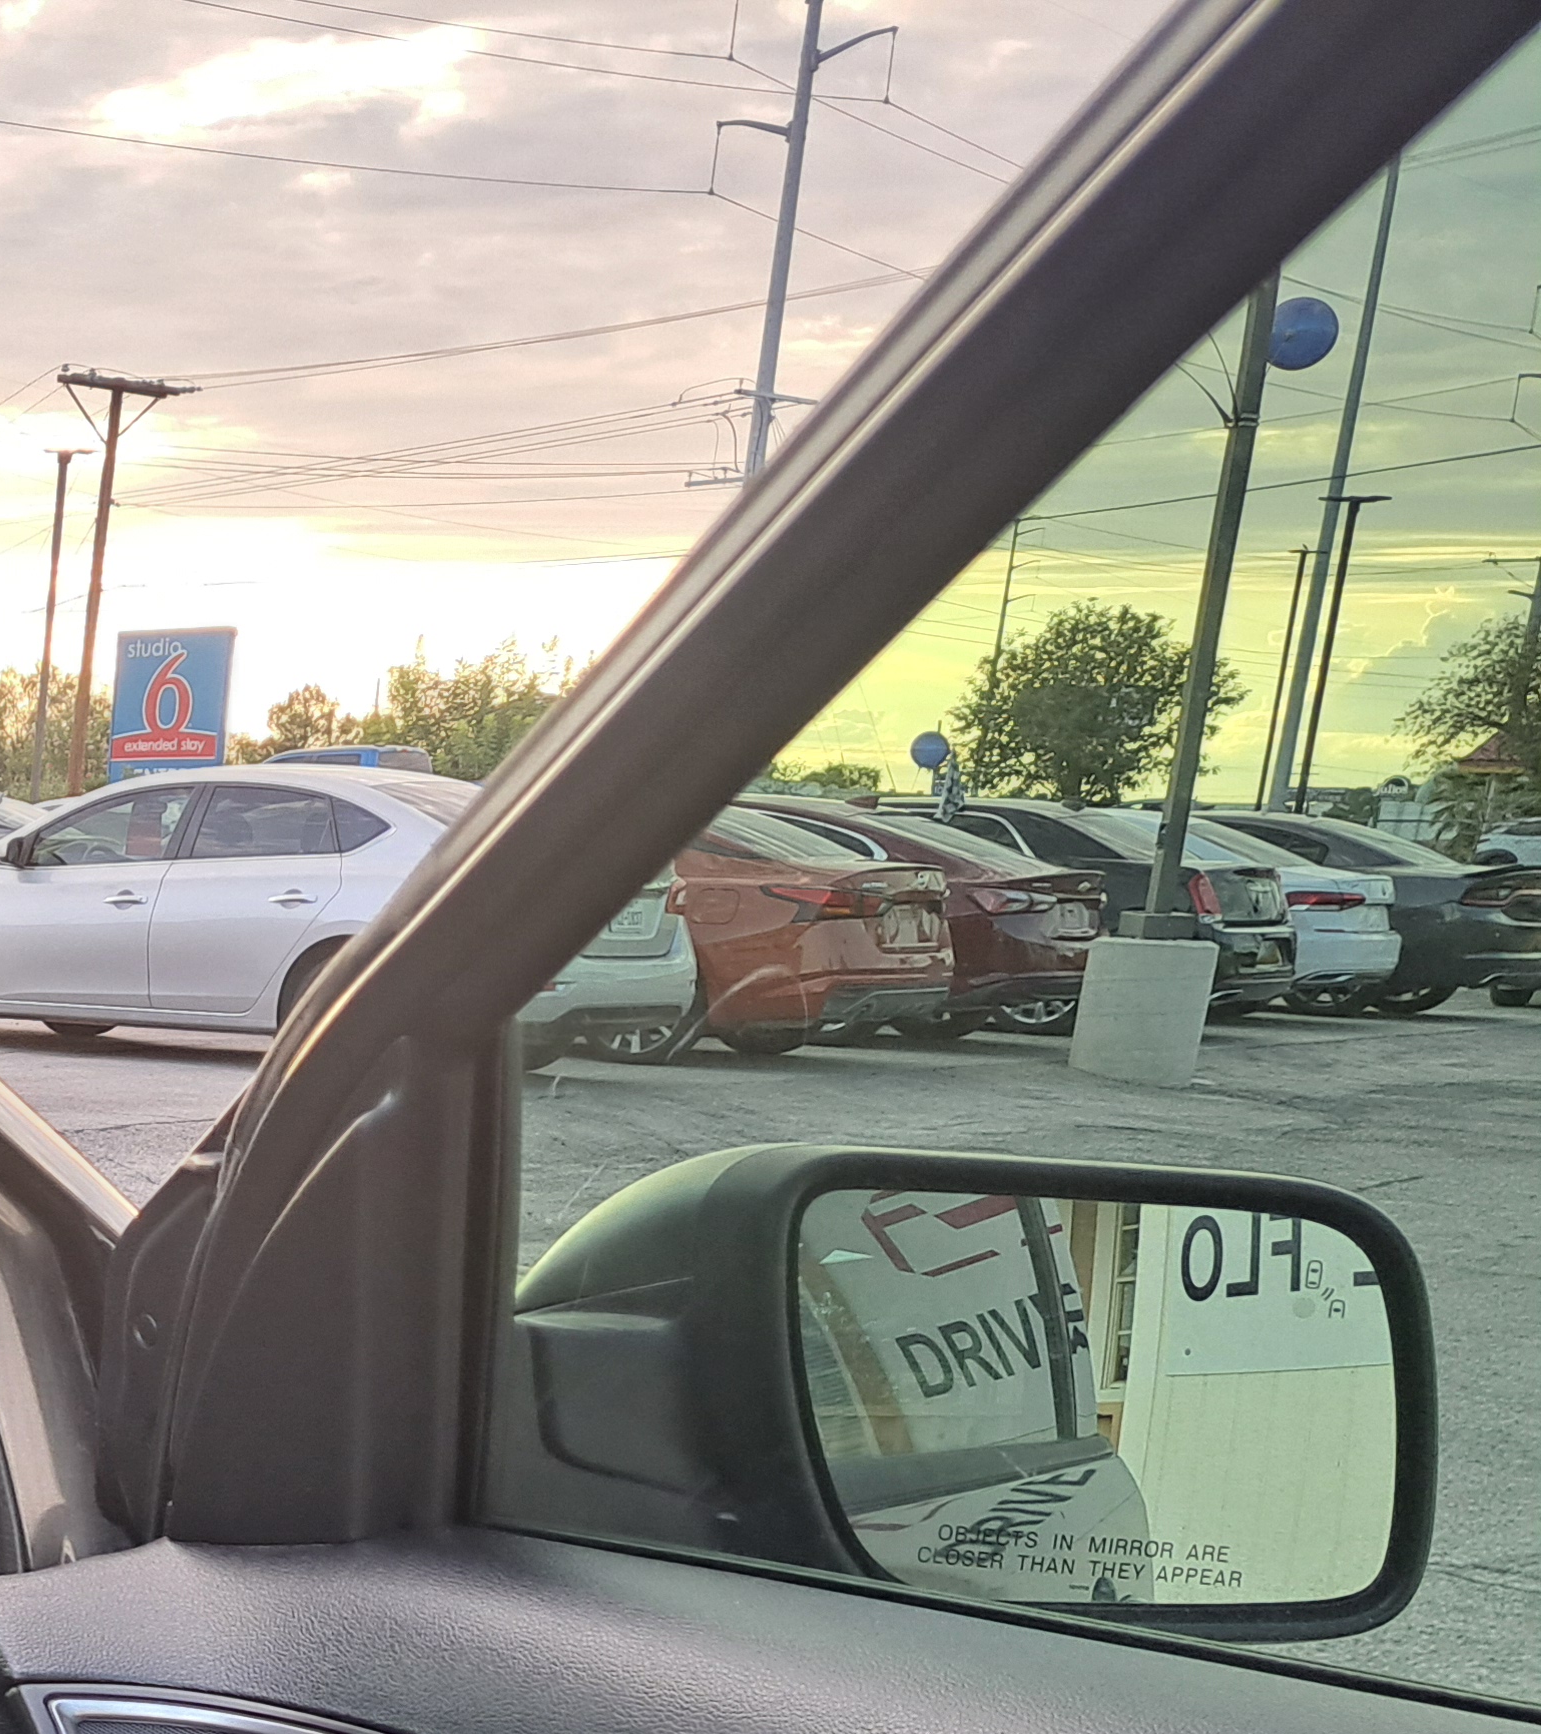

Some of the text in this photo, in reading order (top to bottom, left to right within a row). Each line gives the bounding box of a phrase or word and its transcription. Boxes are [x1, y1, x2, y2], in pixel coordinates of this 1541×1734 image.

[127, 638, 182, 658] studio
[142, 649, 193, 731] 6
[124, 738, 205, 754] extended stay
[938, 1524, 1231, 1563] OBJECTS IN MIRROR ARE
[917, 1546, 1243, 1588] CLOSER THAN THEY APPEAR
